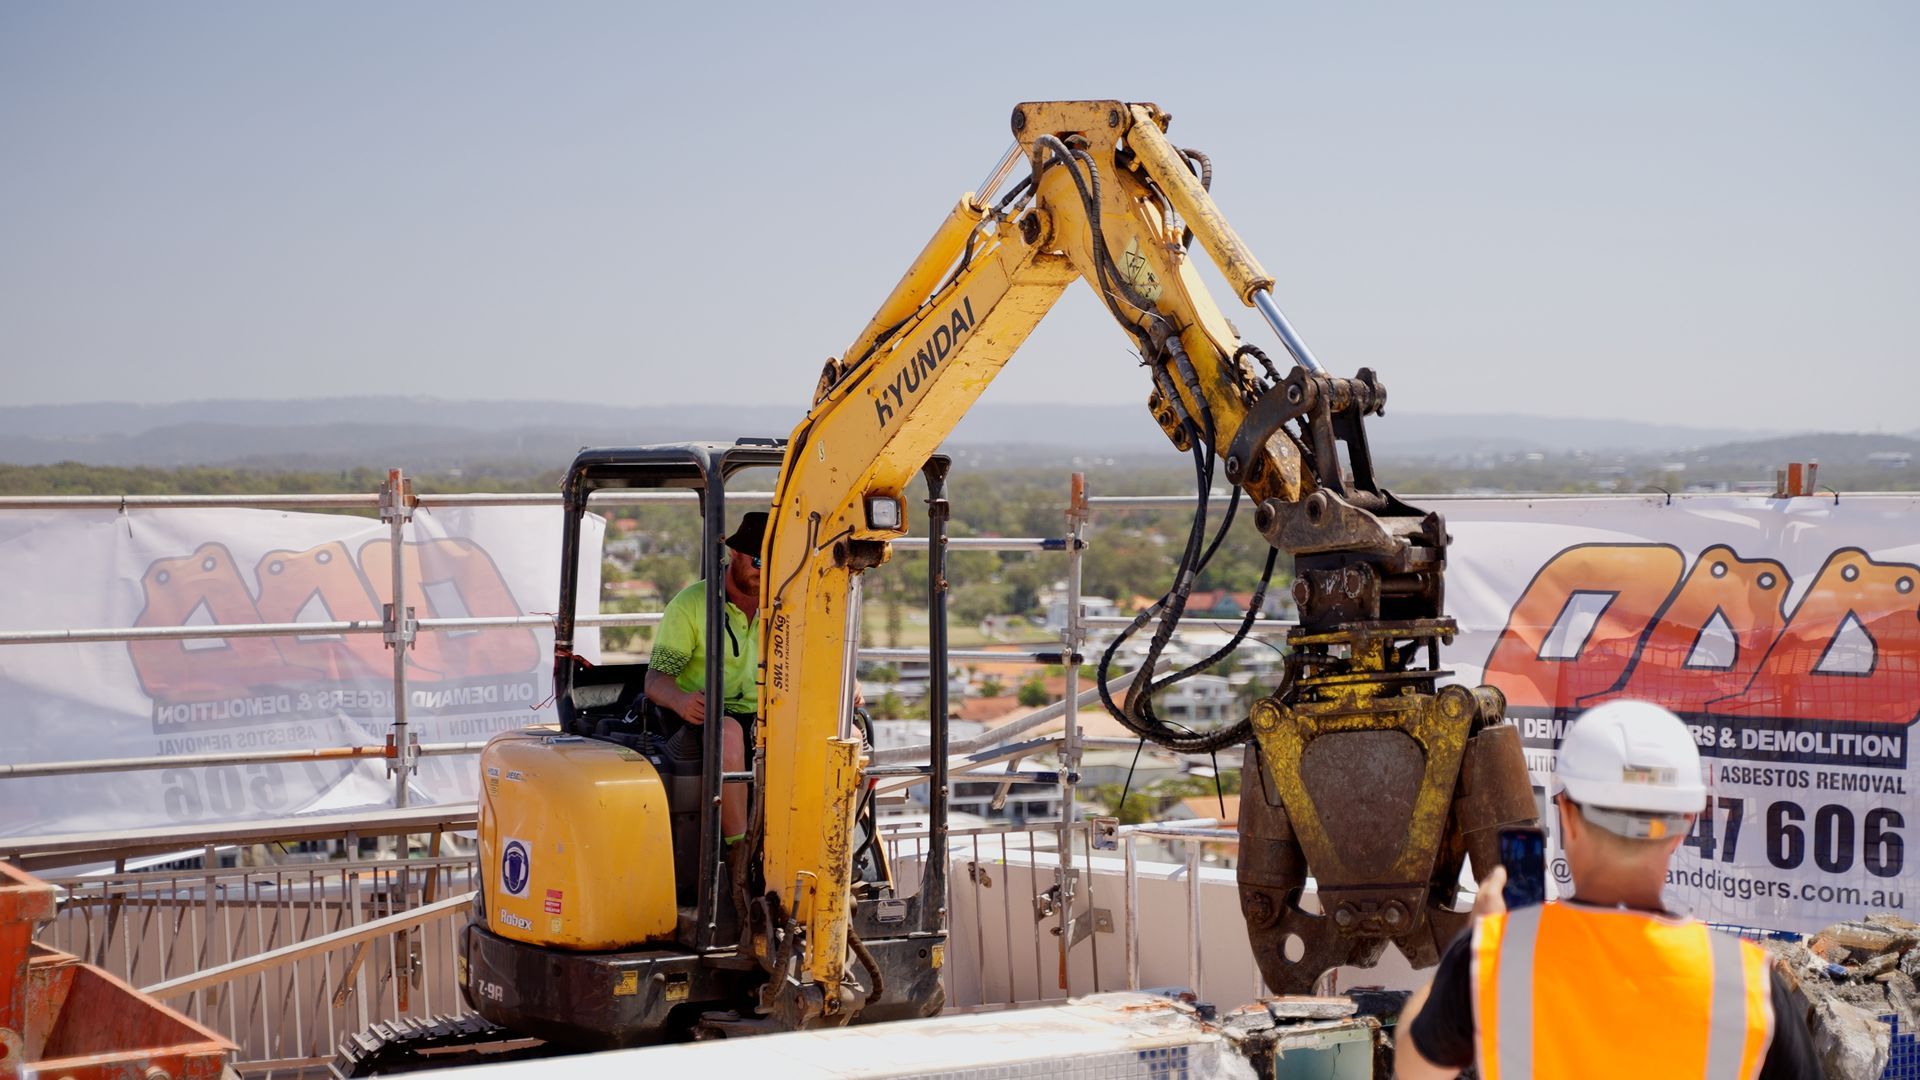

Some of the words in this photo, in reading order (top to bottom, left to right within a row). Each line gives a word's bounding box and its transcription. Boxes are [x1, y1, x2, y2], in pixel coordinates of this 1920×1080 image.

[875, 296, 975, 428] HYUNDAI
[775, 614, 786, 632] Kg
[774, 634, 784, 658] 310
[773, 663, 783, 690] SWL
[1524, 718, 1575, 739] DEMA
[1720, 727, 1737, 748] &
[1742, 729, 1901, 758] DEMOLITION
[1721, 766, 1810, 788] ASBESTOS
[1817, 771, 1907, 795] REMOVAL
[1683, 795, 1744, 863] 47
[1766, 801, 1905, 878] 606
[501, 909, 533, 931] Robex
